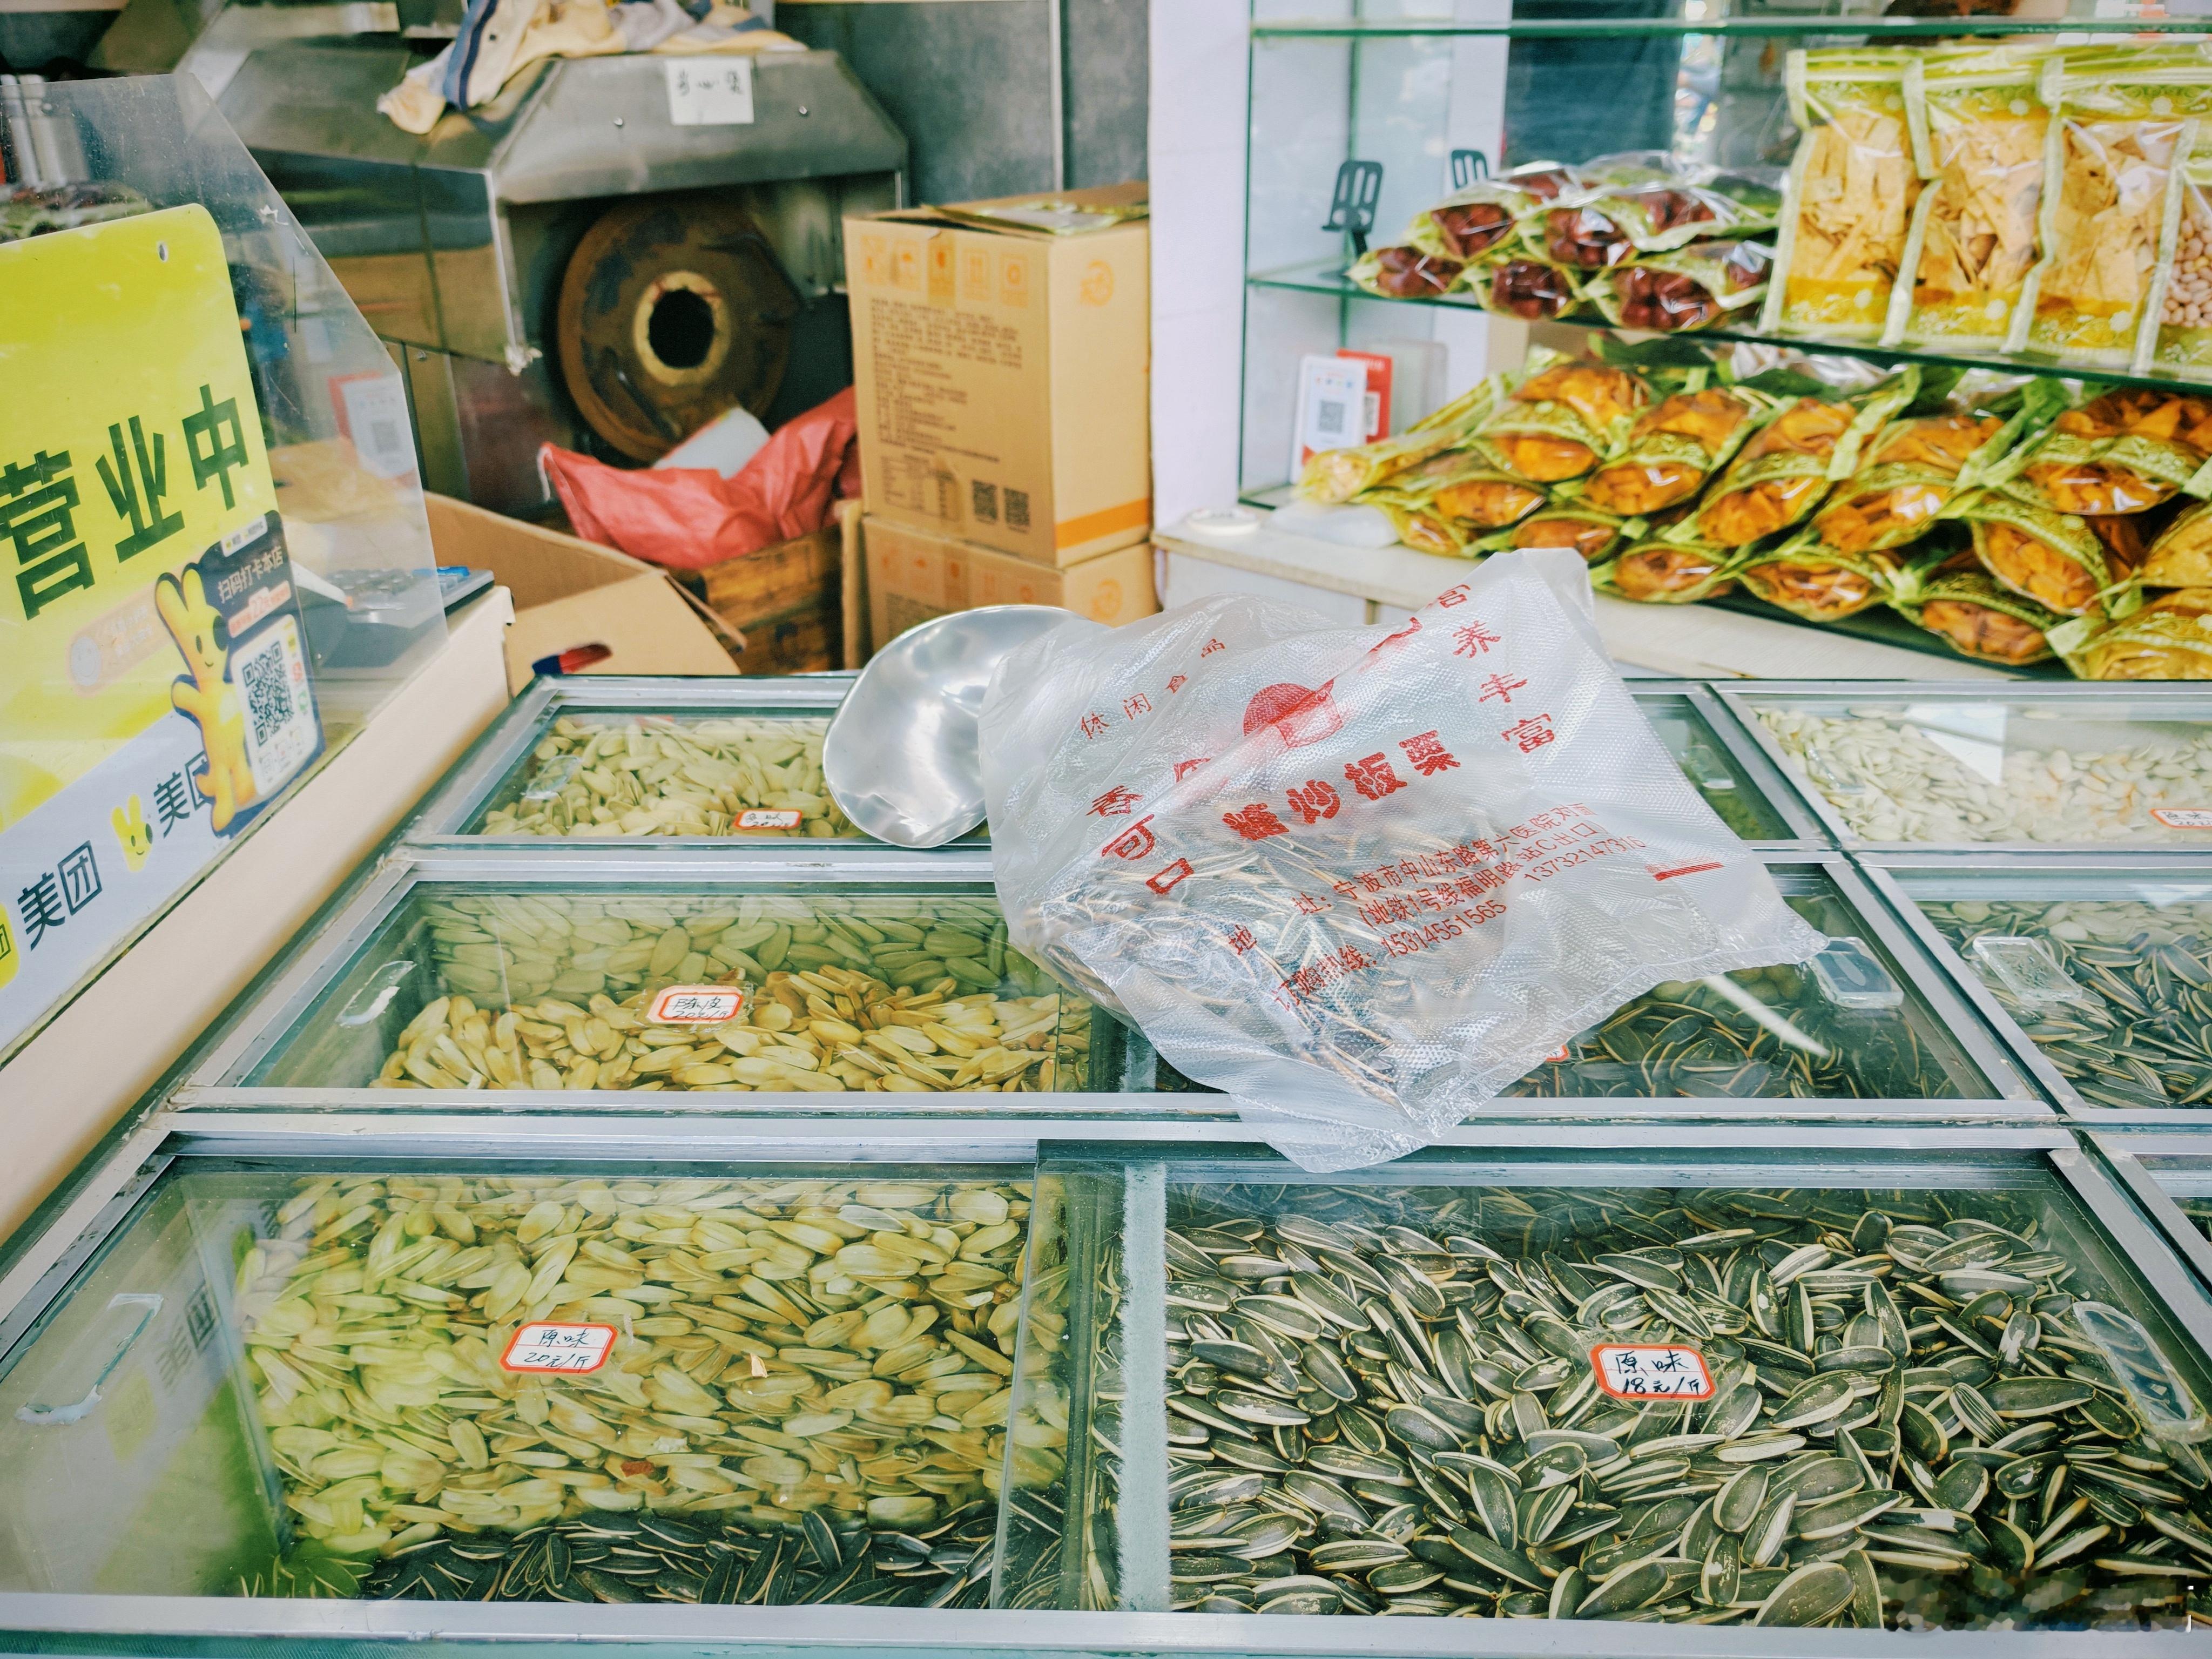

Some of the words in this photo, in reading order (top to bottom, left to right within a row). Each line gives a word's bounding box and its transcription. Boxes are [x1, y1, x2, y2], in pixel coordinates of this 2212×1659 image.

[0, 384, 249, 621] 营业中
[218, 545, 284, 604] 扫码打卡本店
[1523, 835, 1646, 884] 13732147316
[17, 840, 103, 951] 美团
[1381, 900, 1507, 959] 15314551565
[539, 1328, 590, 1347] 原味
[524, 1352, 591, 1373] 20元/斤
[1615, 1349, 1689, 1377] 原味
[1622, 1377, 1699, 1399] 18元/斤
